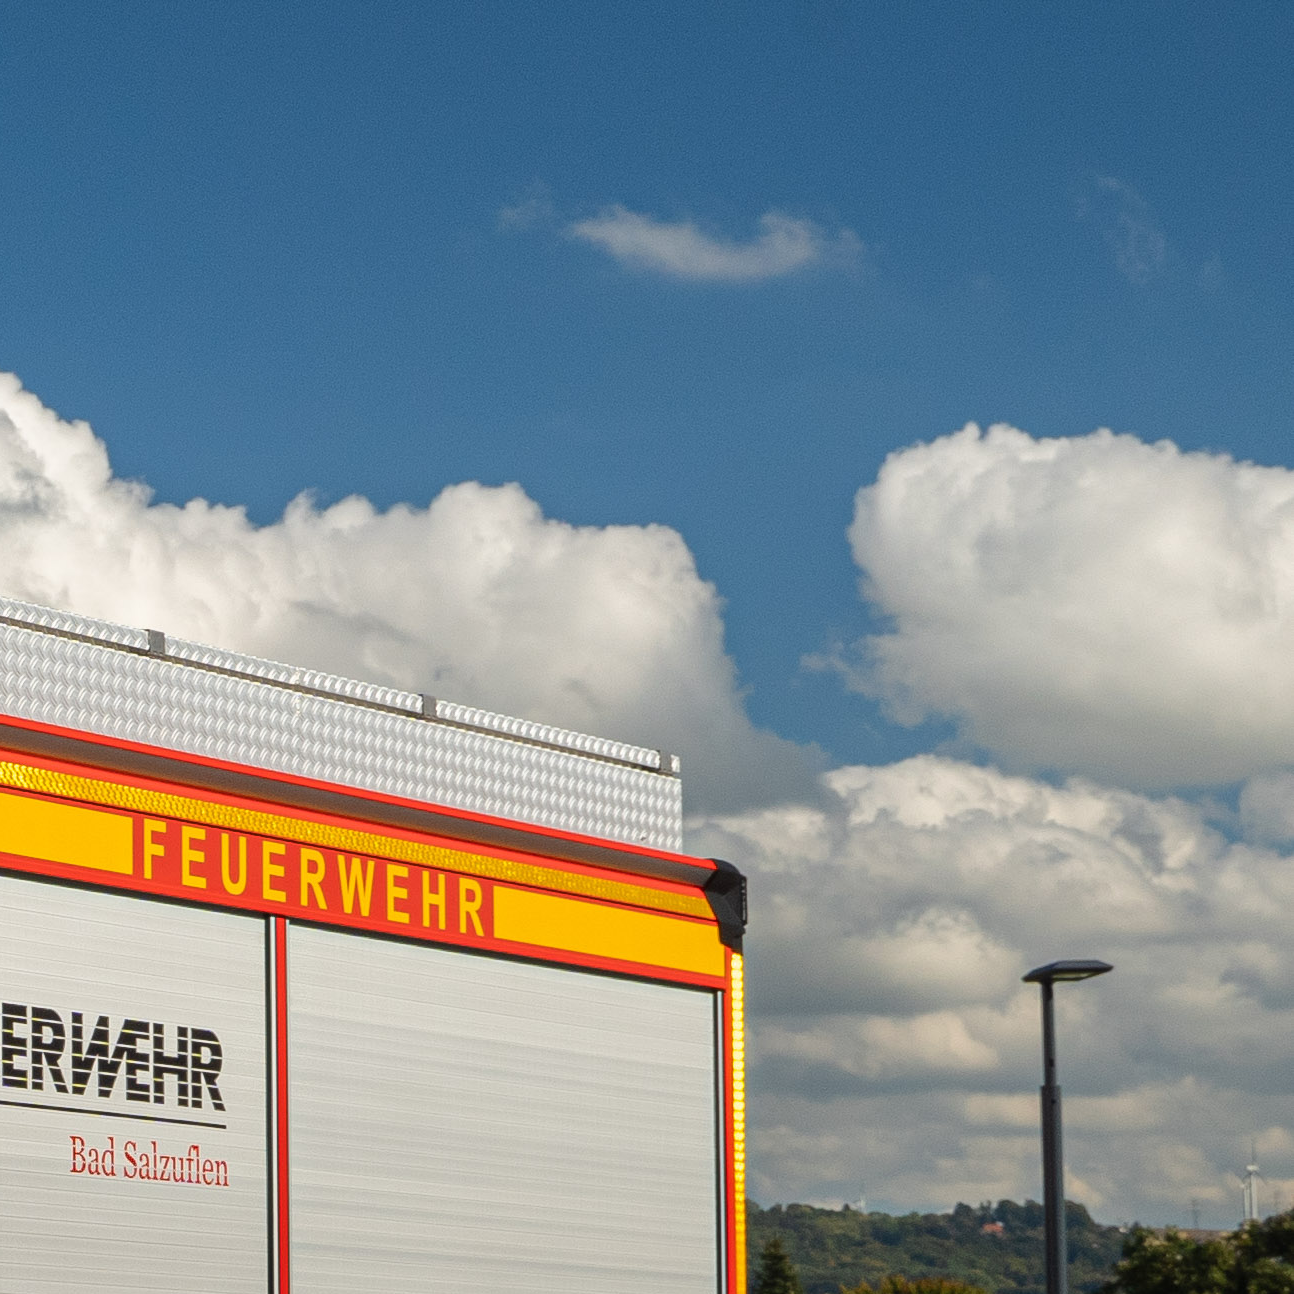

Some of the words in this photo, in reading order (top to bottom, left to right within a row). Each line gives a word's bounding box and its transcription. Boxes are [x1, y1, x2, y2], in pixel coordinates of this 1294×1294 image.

[143, 817, 485, 938] FEUERWEHR
[69, 1135, 116, 1177] Bad
[123, 1140, 230, 1187] Salzuflen
